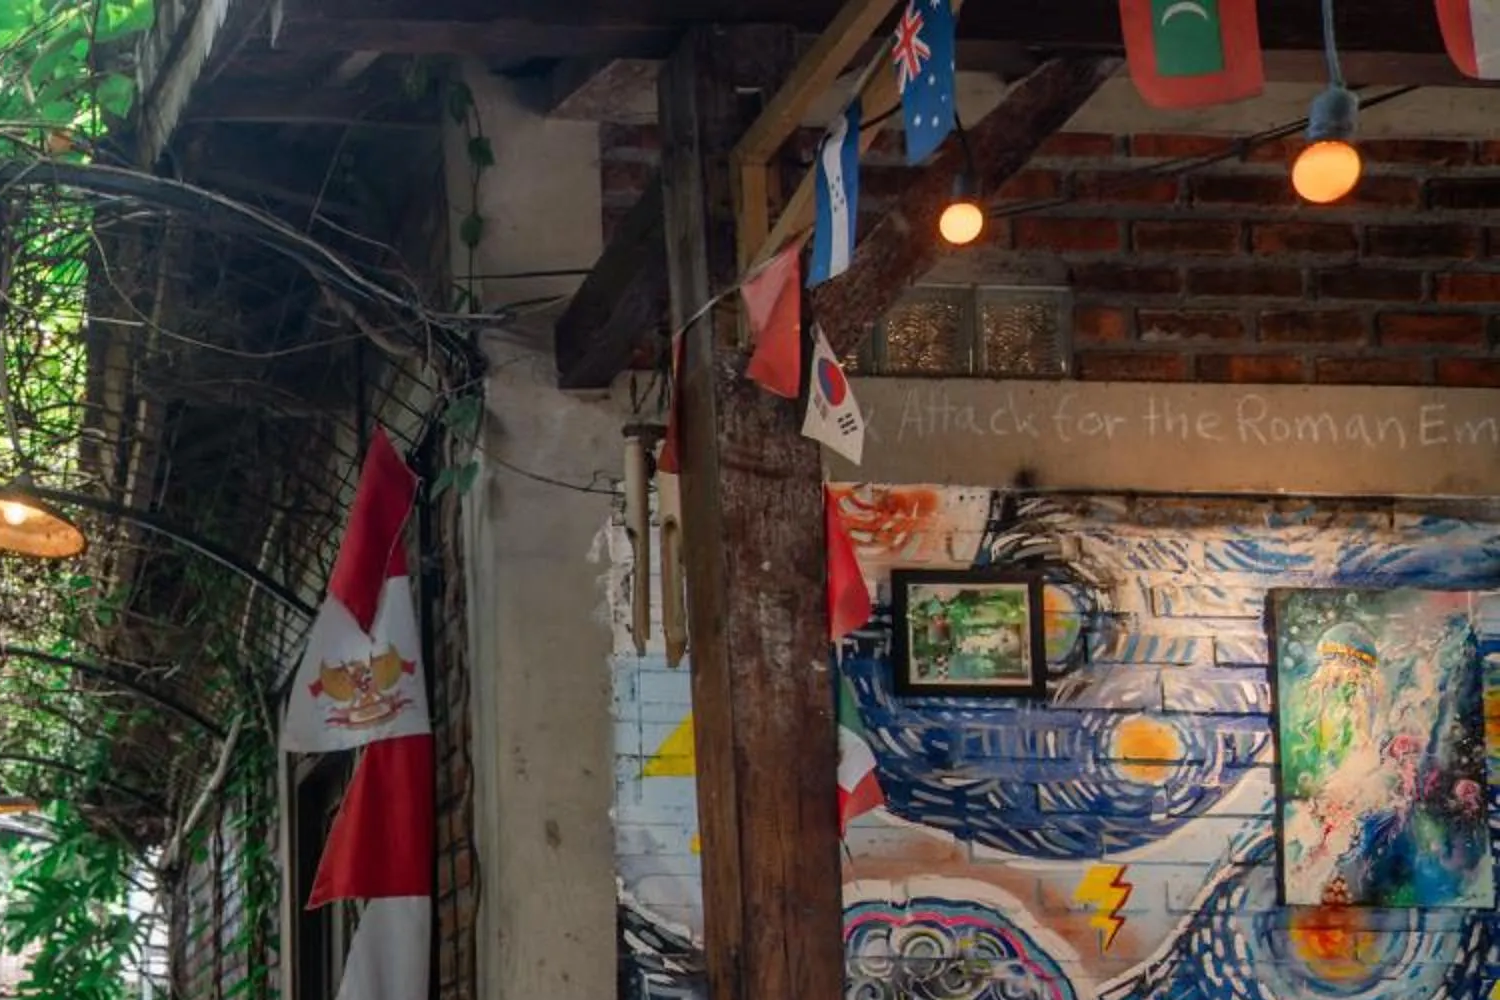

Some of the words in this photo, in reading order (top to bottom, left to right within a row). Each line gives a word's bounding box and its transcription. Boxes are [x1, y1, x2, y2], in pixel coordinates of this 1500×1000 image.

[897, 382, 1040, 442] Attack
[1050, 391, 1128, 443] for
[1141, 389, 1229, 443] the
[1235, 392, 1407, 450] Roman
